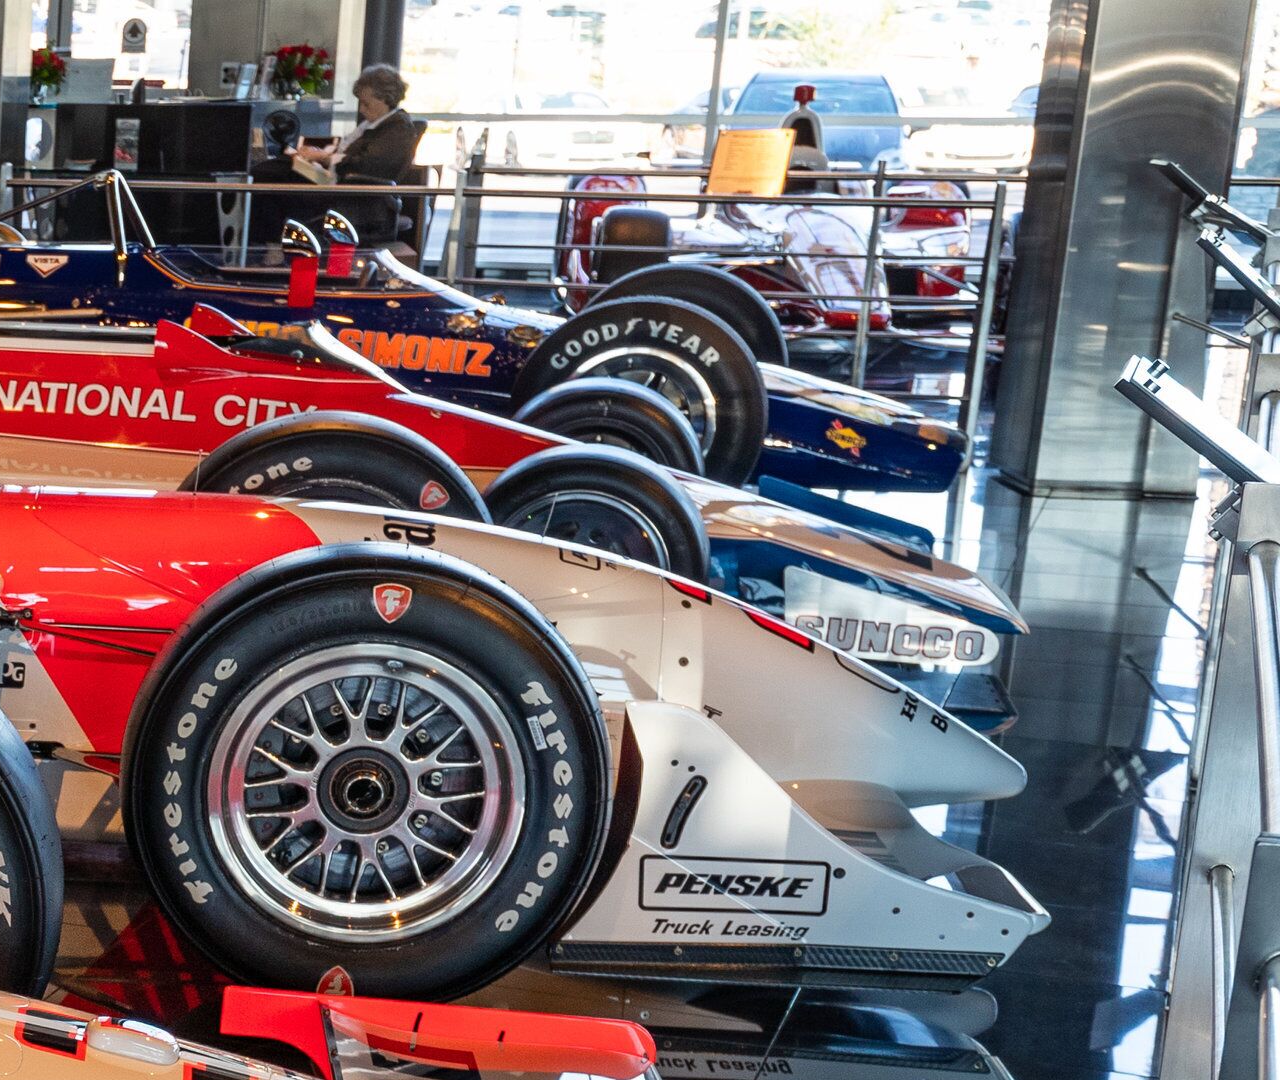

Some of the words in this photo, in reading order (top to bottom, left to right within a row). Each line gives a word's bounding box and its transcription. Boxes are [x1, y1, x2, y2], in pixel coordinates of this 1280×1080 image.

[33, 257, 60, 265] VISTA
[338, 329, 495, 377] SIMONIZ
[213, 394, 318, 428] CIT
[795, 615, 985, 661] SUNOCO
[163, 656, 238, 904] Firestone
[495, 681, 574, 932] Firestone
[654, 873, 814, 900] PENSKE
[651, 918, 713, 937] Truck
[720, 920, 810, 941] Leasing
